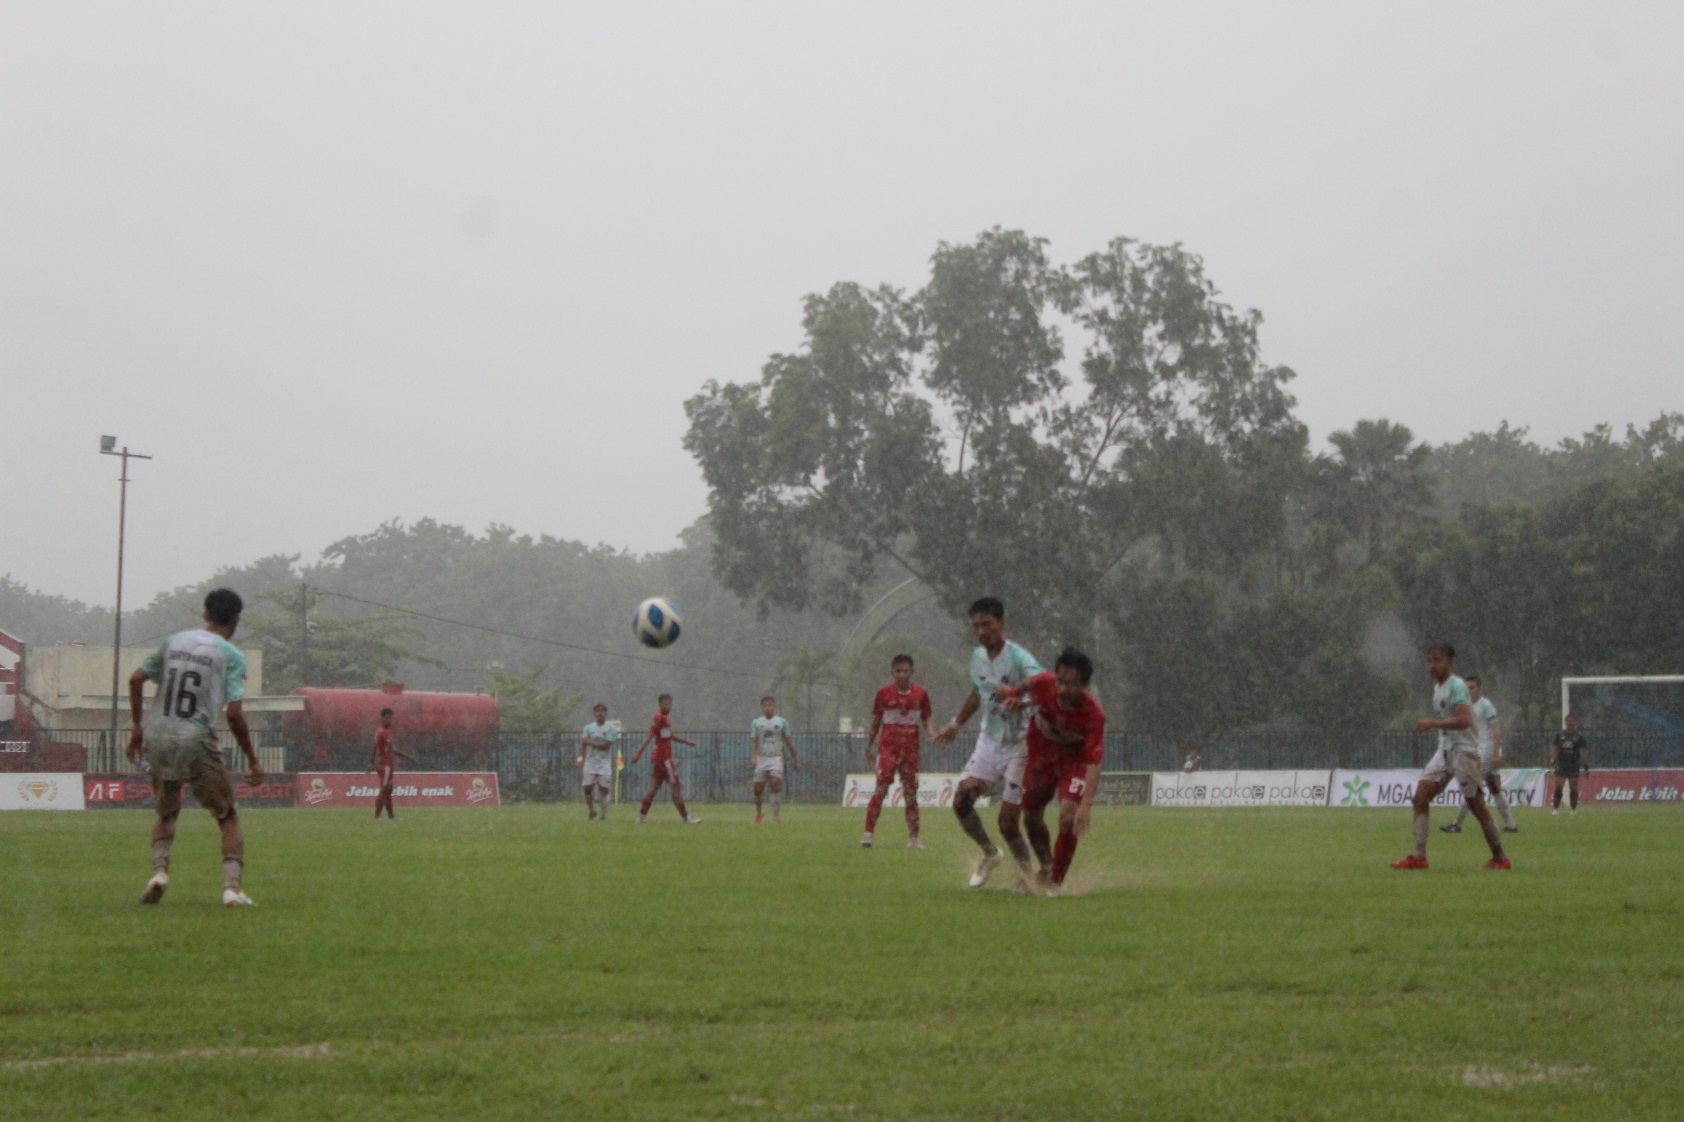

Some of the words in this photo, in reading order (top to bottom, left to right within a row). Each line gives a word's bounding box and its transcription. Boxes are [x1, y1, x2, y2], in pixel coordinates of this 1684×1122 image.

[163, 668, 201, 719] 16
[346, 786, 379, 797] Jelas
[391, 786, 417, 797] ebih
[422, 786, 453, 797] enak
[1377, 783, 1413, 804] MGA
[1595, 786, 1636, 801] Jelas
[1638, 786, 1679, 801] lebih
